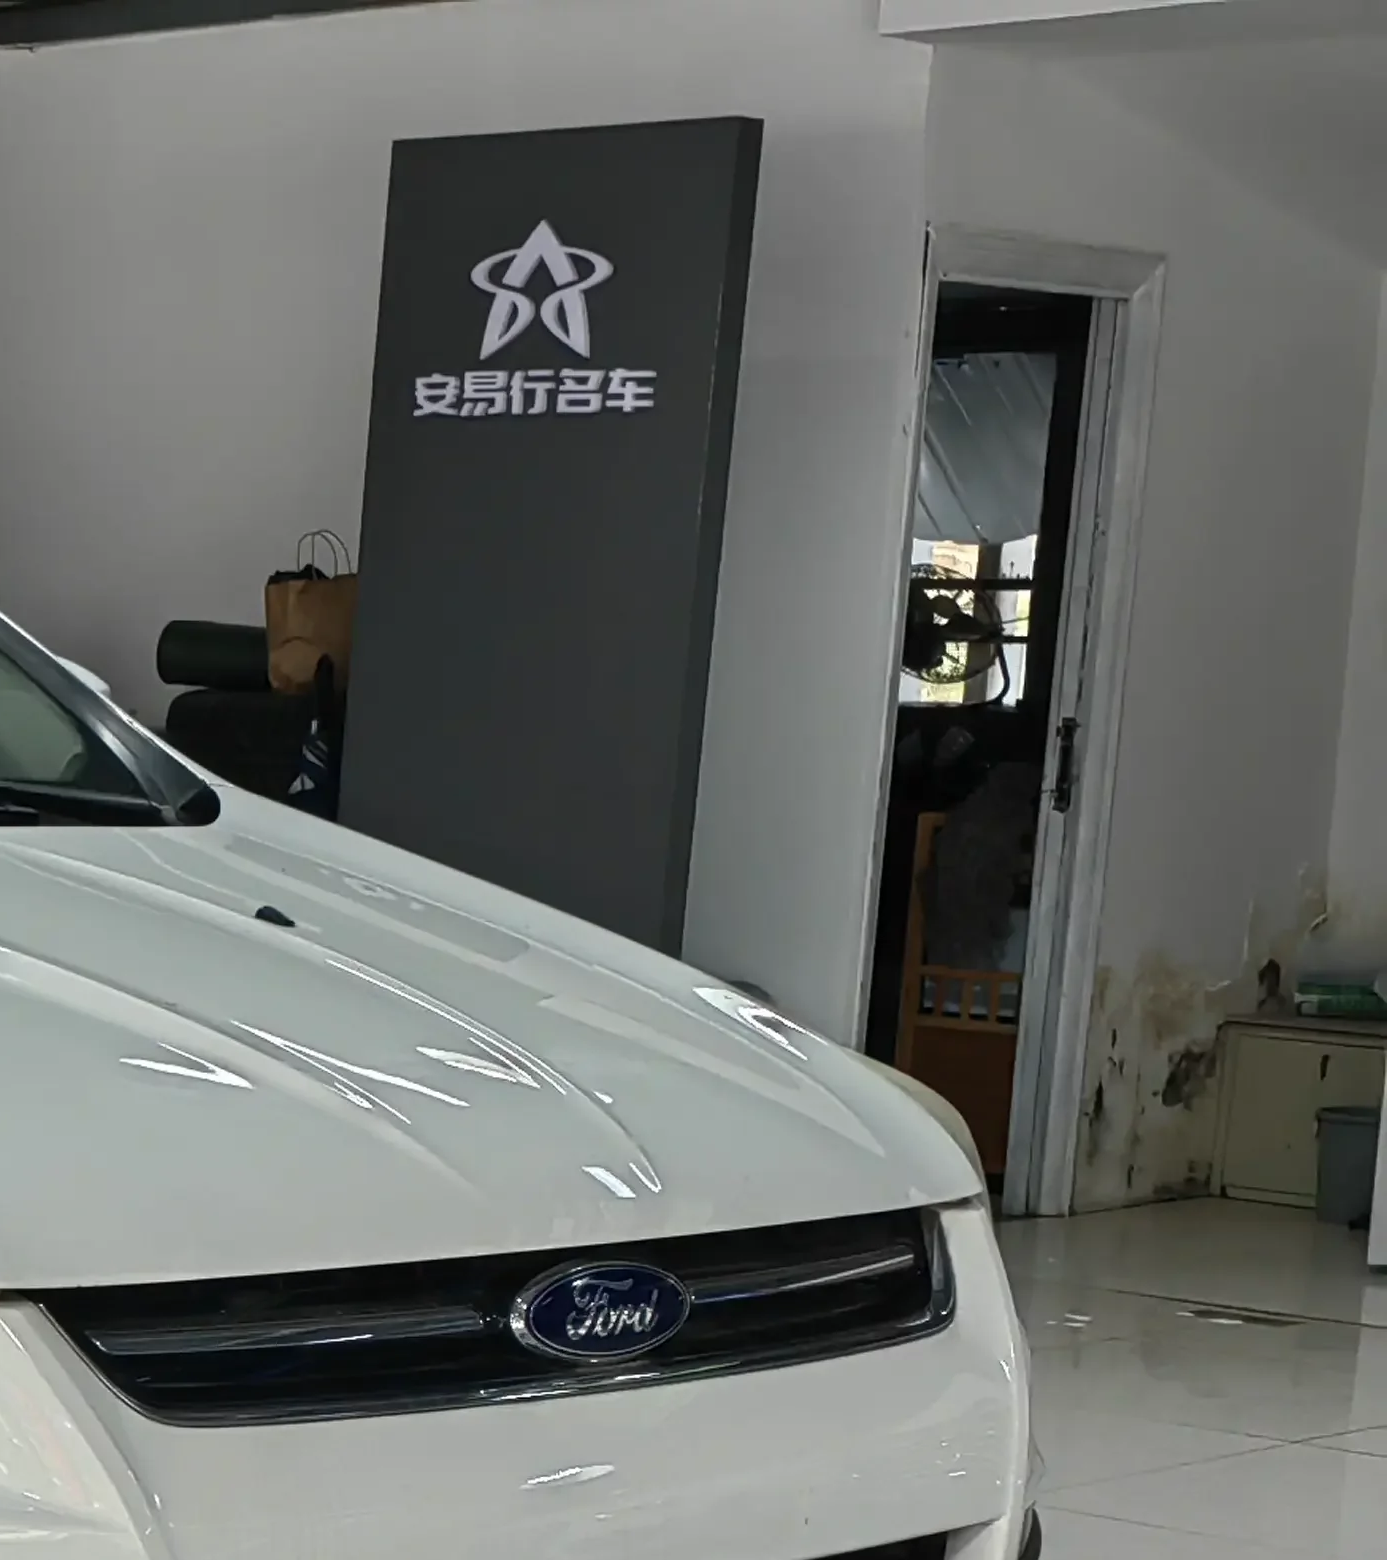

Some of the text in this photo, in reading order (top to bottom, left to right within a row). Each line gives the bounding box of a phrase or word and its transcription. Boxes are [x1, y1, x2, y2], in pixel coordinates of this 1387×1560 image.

[413, 367, 658, 417] 安易行名车
[566, 1277, 659, 1341] Ford
